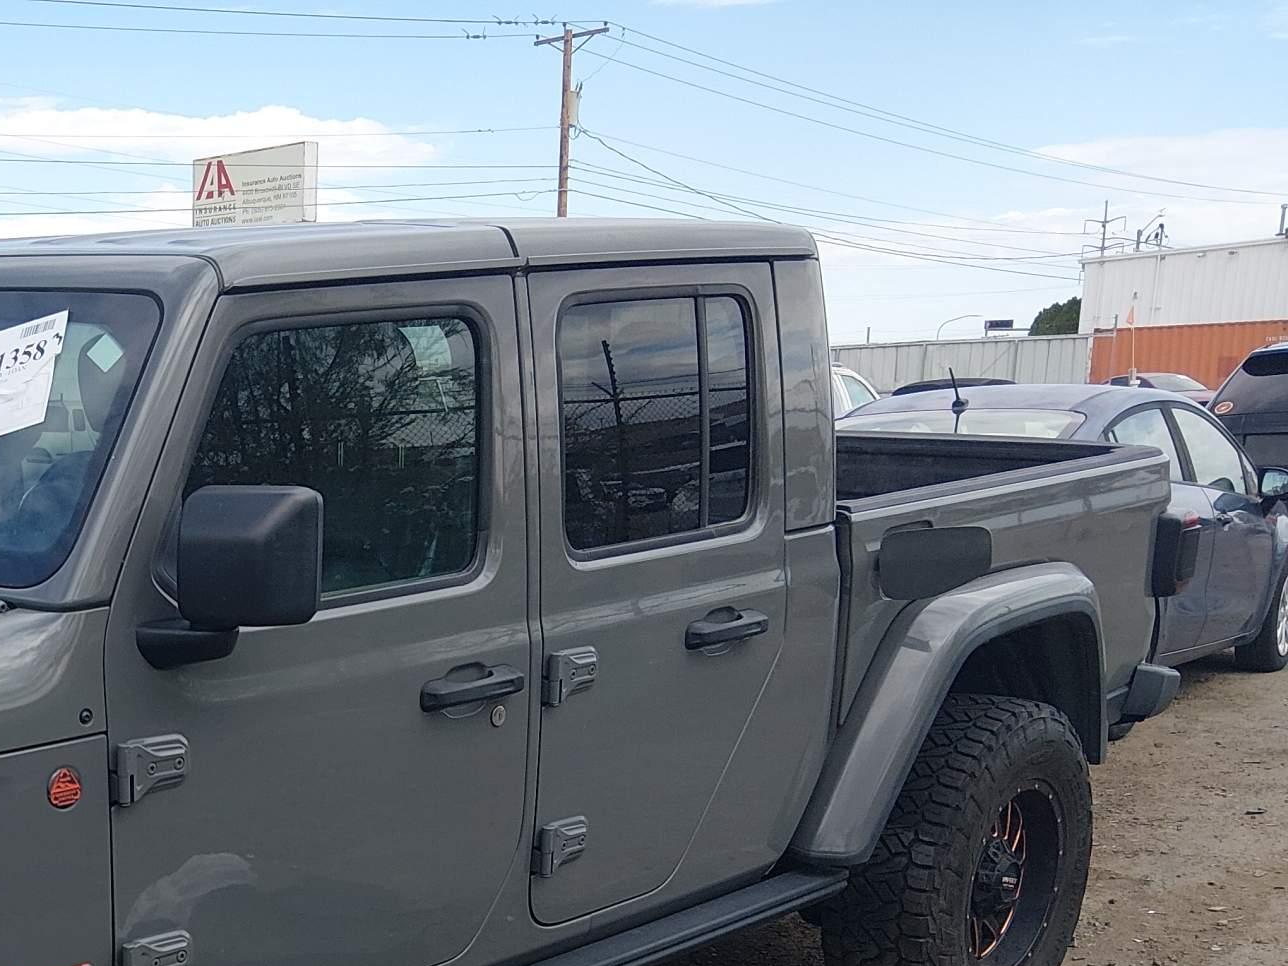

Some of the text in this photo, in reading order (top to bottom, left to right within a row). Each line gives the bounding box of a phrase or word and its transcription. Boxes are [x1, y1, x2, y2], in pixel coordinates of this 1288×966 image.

[195, 203, 236, 215] INSURANCE
[195, 215, 236, 228] AUTO AUCTIONS
